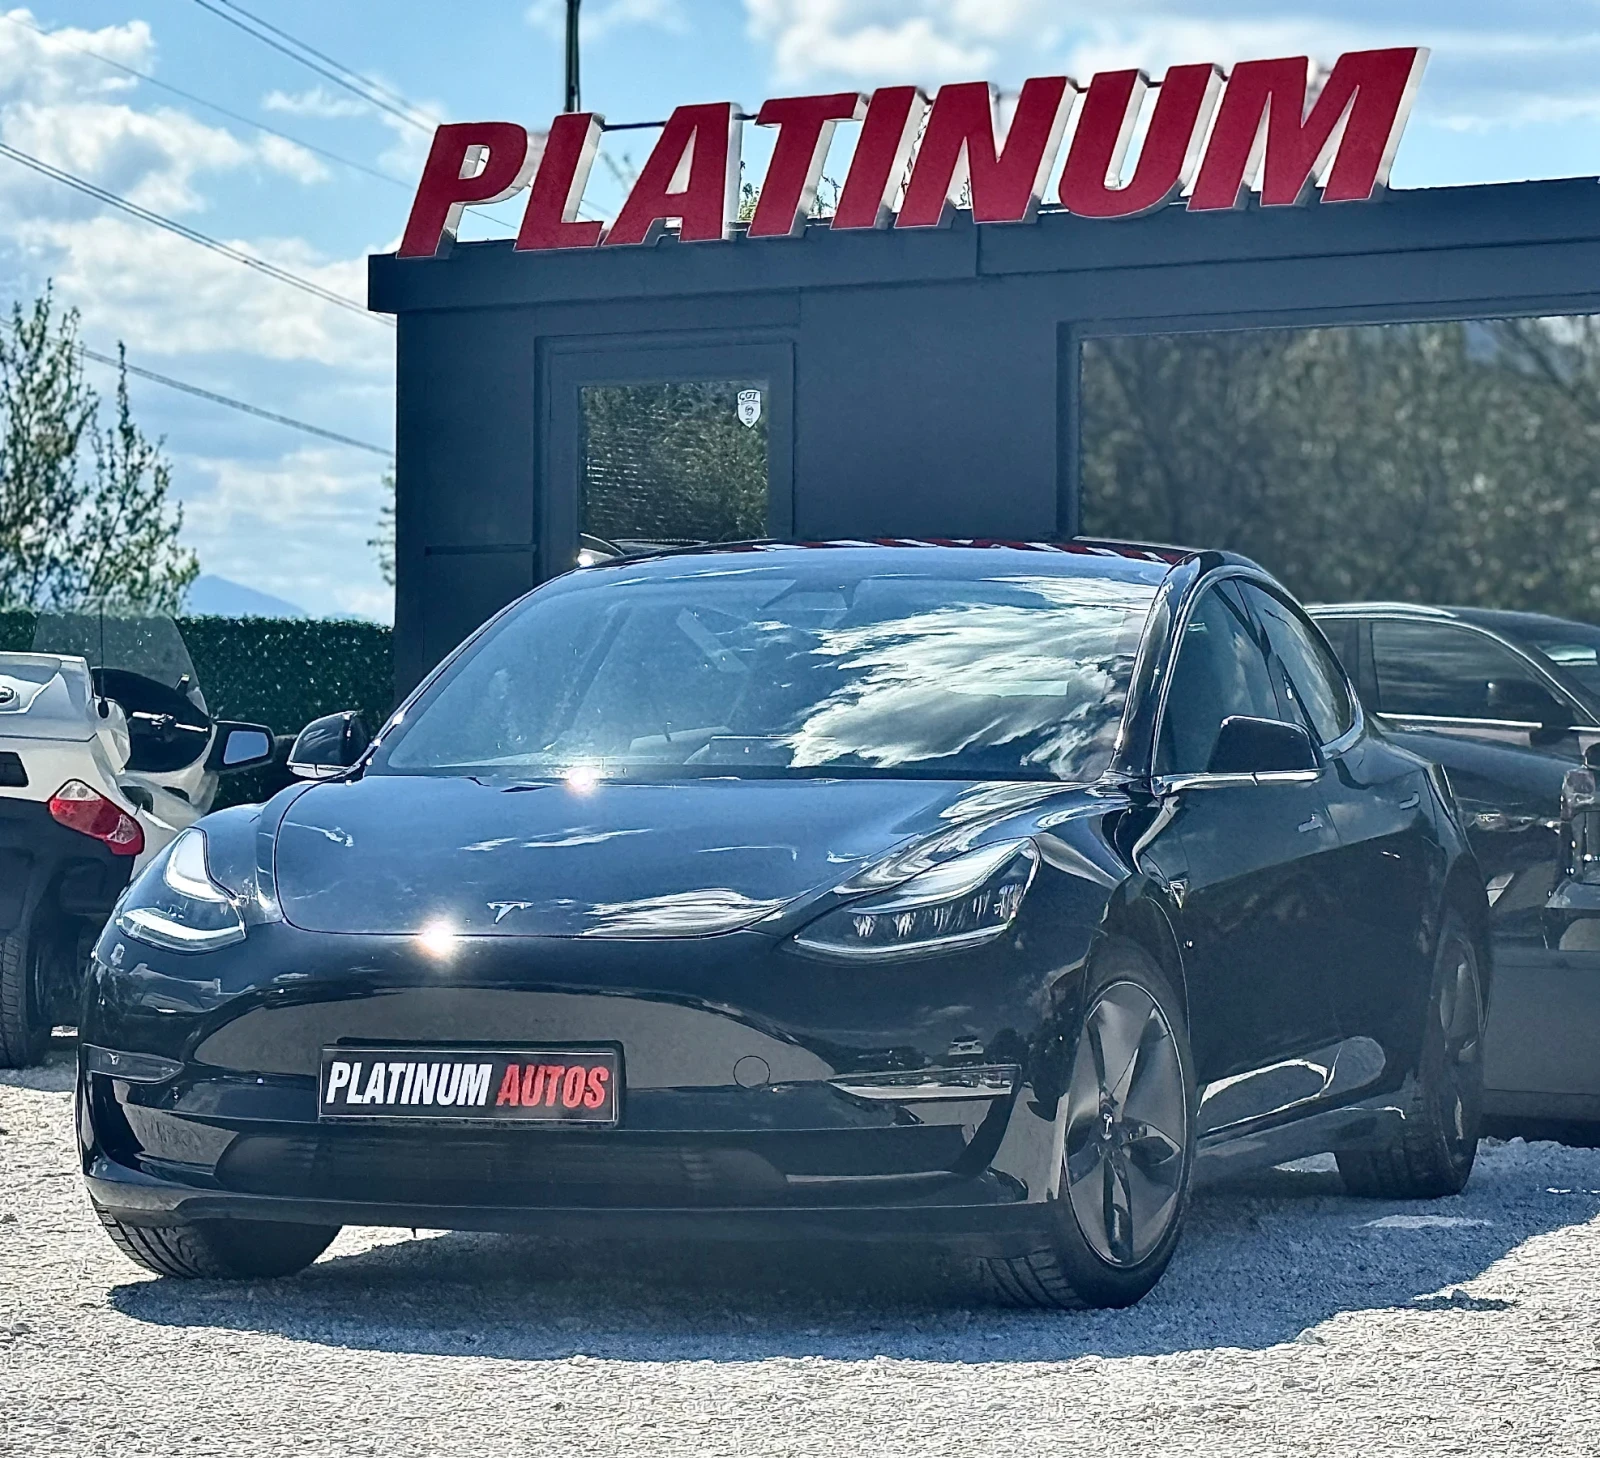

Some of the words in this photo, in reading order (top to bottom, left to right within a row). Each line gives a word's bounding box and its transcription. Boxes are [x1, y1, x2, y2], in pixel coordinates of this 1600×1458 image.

[396, 47, 1424, 258] PLATINUM
[325, 1061, 493, 1107] PLATINUM
[495, 1063, 610, 1109] AUTOS
